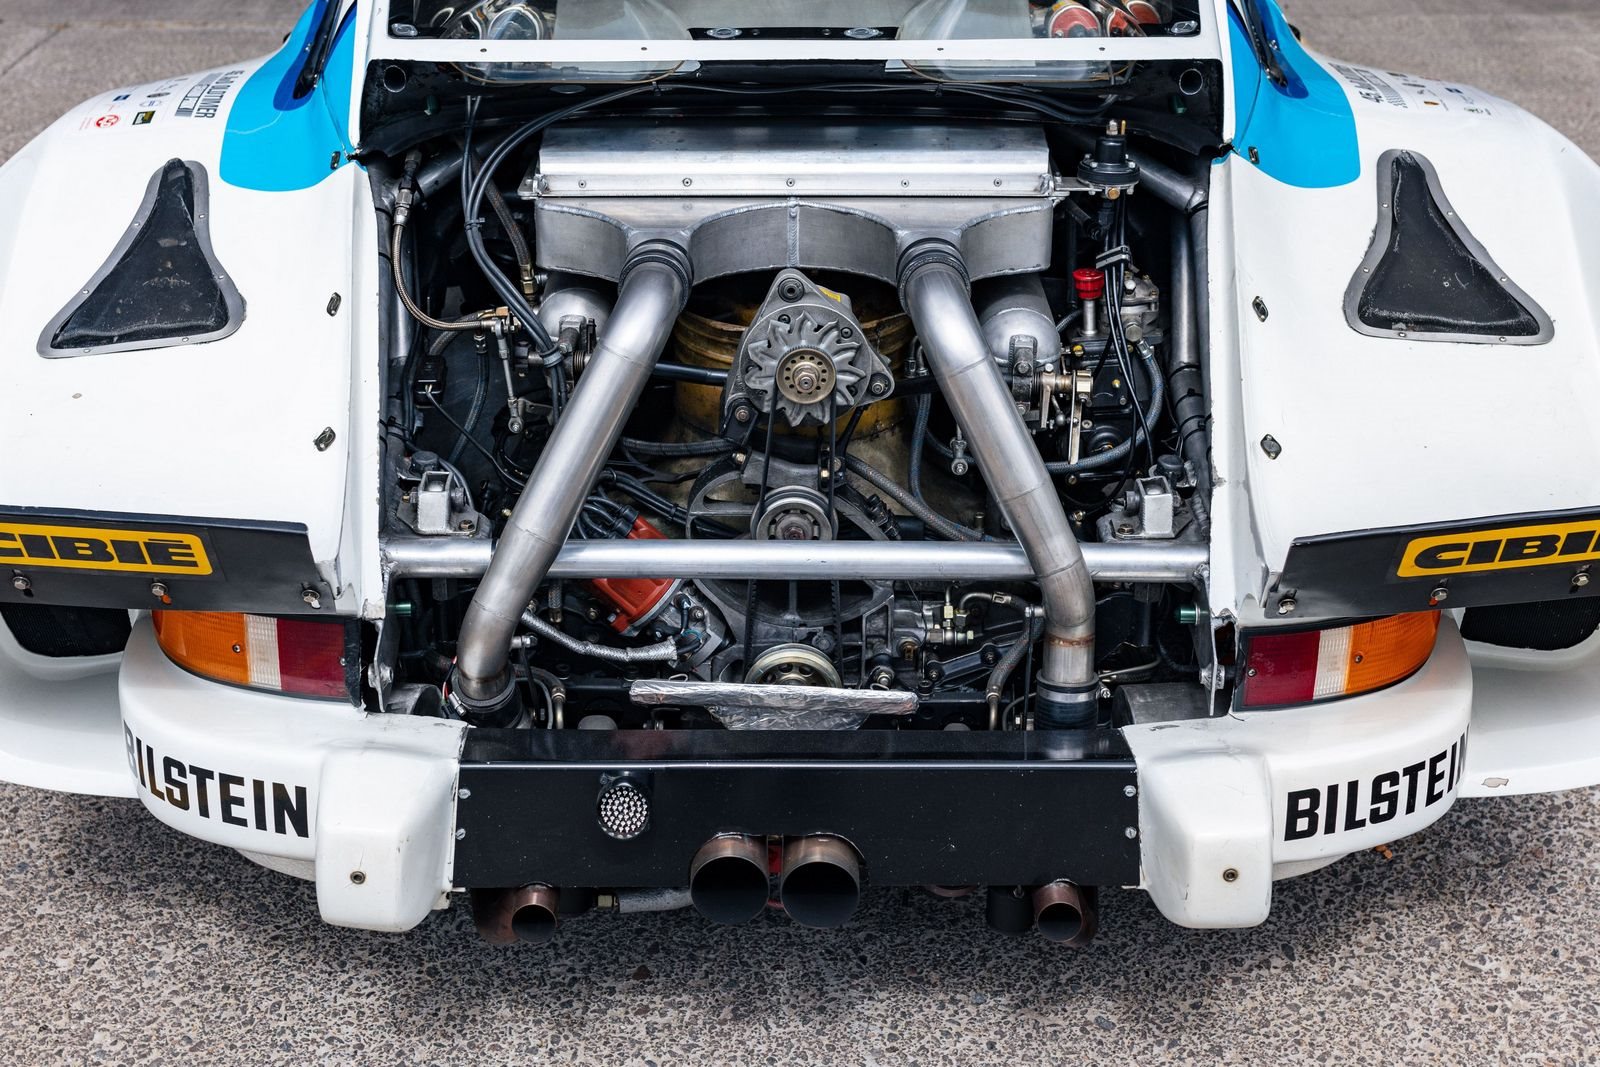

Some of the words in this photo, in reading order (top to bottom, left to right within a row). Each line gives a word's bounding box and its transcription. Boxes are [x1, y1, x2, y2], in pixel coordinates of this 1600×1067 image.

[1414, 528, 1600, 569] CIBI
[124, 720, 309, 838] BILSTEIN
[1284, 723, 1469, 841] BILSTEIN
